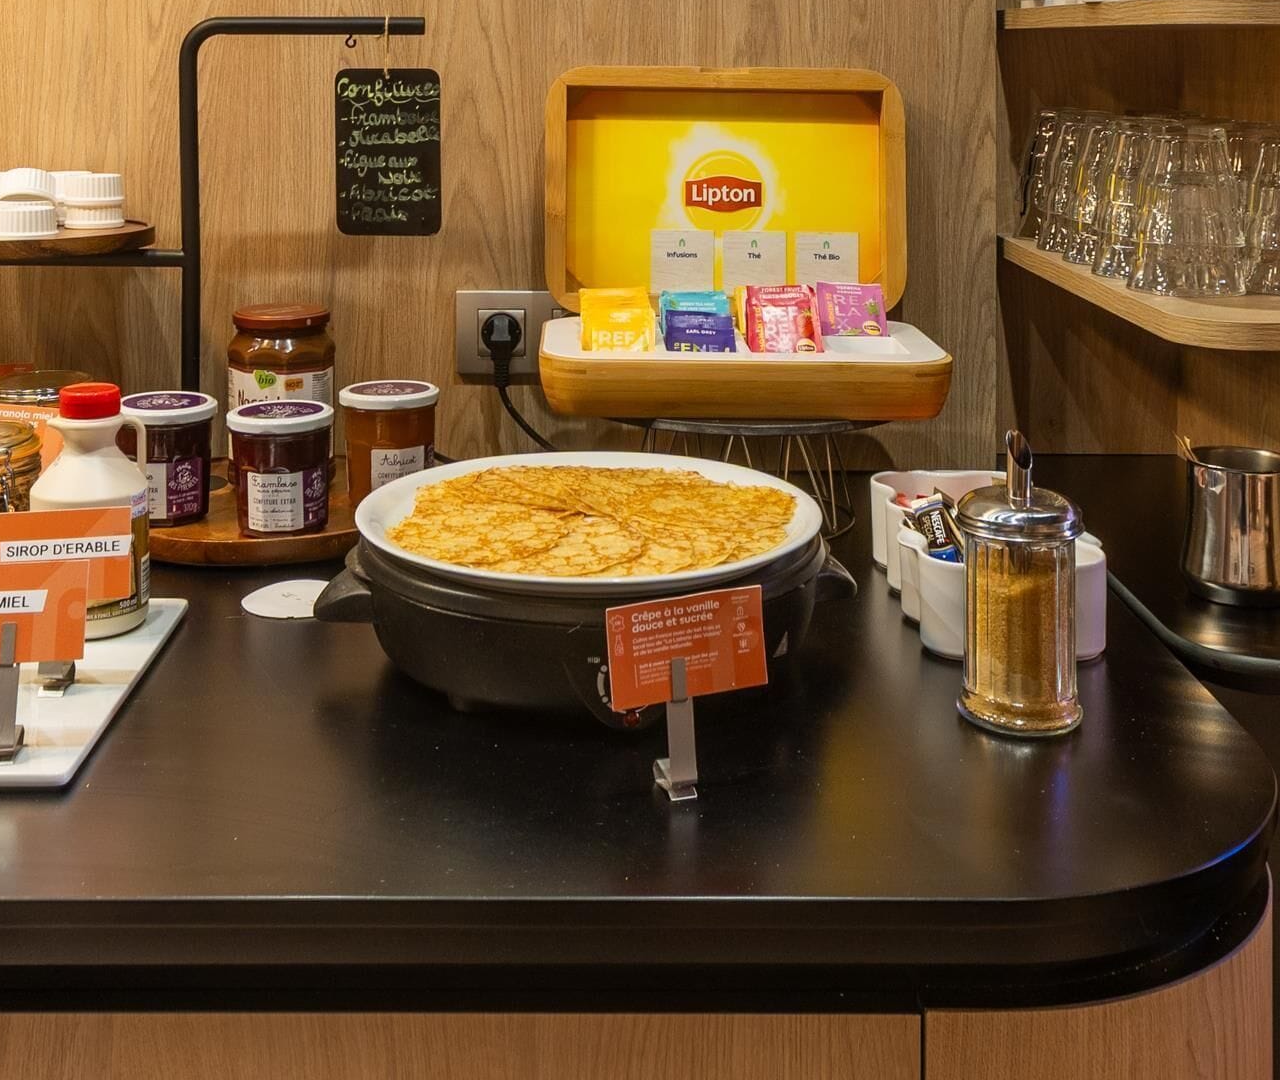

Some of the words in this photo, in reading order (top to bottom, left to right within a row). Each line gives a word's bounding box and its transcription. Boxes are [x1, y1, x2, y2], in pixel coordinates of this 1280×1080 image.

[691, 183, 756, 206] Lipton
[666, 251, 698, 259] Infusions
[747, 251, 761, 259] Thé
[813, 252, 827, 260] Thé
[828, 252, 841, 260] Bio
[259, 375, 274, 385] bio
[32, 410, 54, 420] miel
[6, 545, 49, 558] SIROP
[53, 540, 121, 555] D'ERABLE
[631, 609, 662, 624] Crêpe
[663, 606, 671, 617] à
[673, 605, 684, 616] la
[686, 600, 720, 614] vanille
[631, 620, 664, 634] douce
[665, 616, 677, 627] et
[679, 611, 713, 625] sucrée
